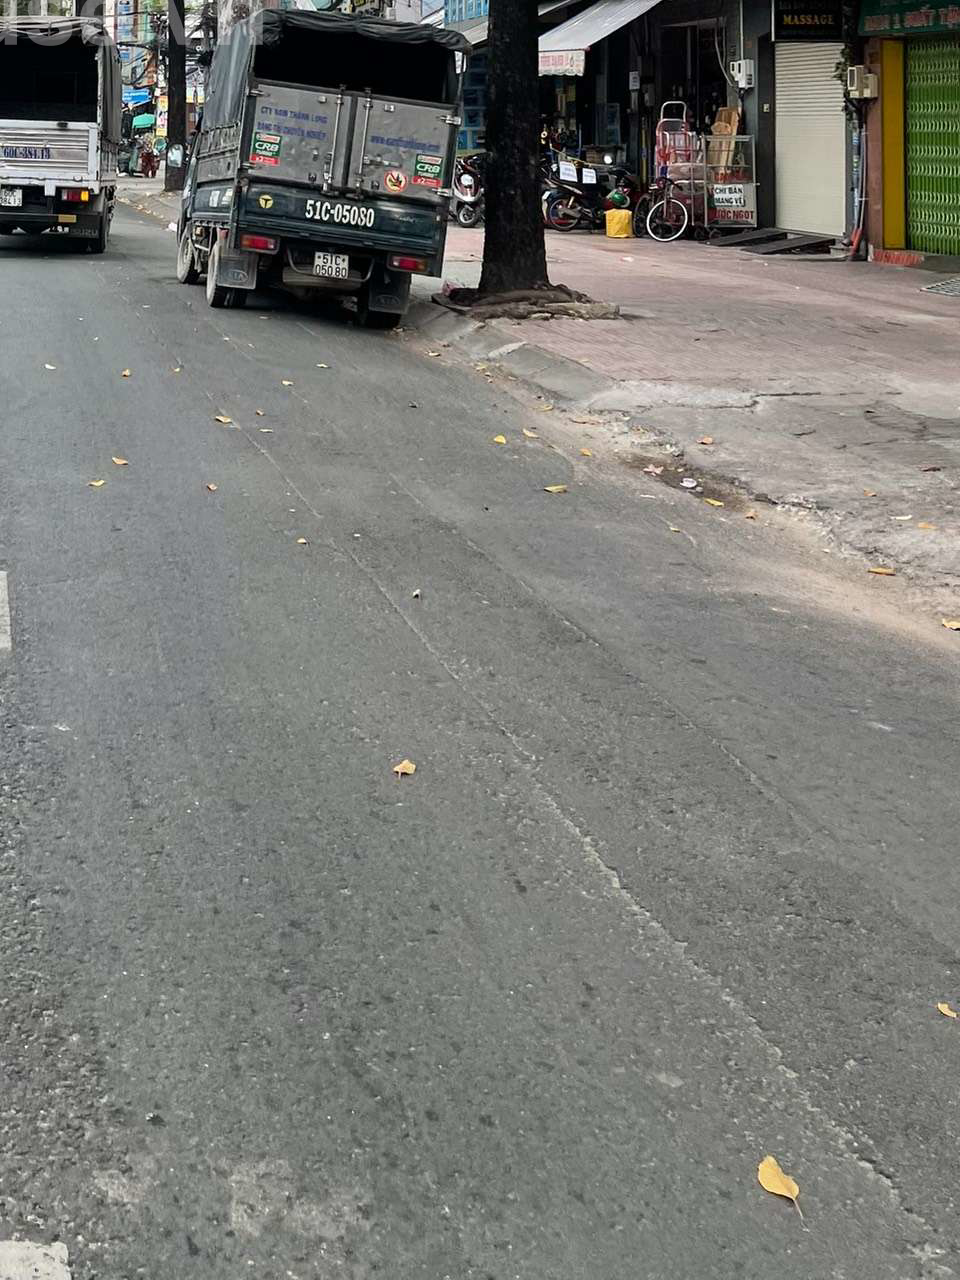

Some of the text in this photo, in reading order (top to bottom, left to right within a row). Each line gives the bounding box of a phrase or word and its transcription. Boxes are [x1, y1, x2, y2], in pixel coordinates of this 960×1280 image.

[783, 14, 835, 25] MASSAGE
[255, 142, 279, 152] CRB
[416, 163, 441, 173] CRB
[305, 199, 375, 228] 51C-05080
[322, 254, 341, 266] 51C
